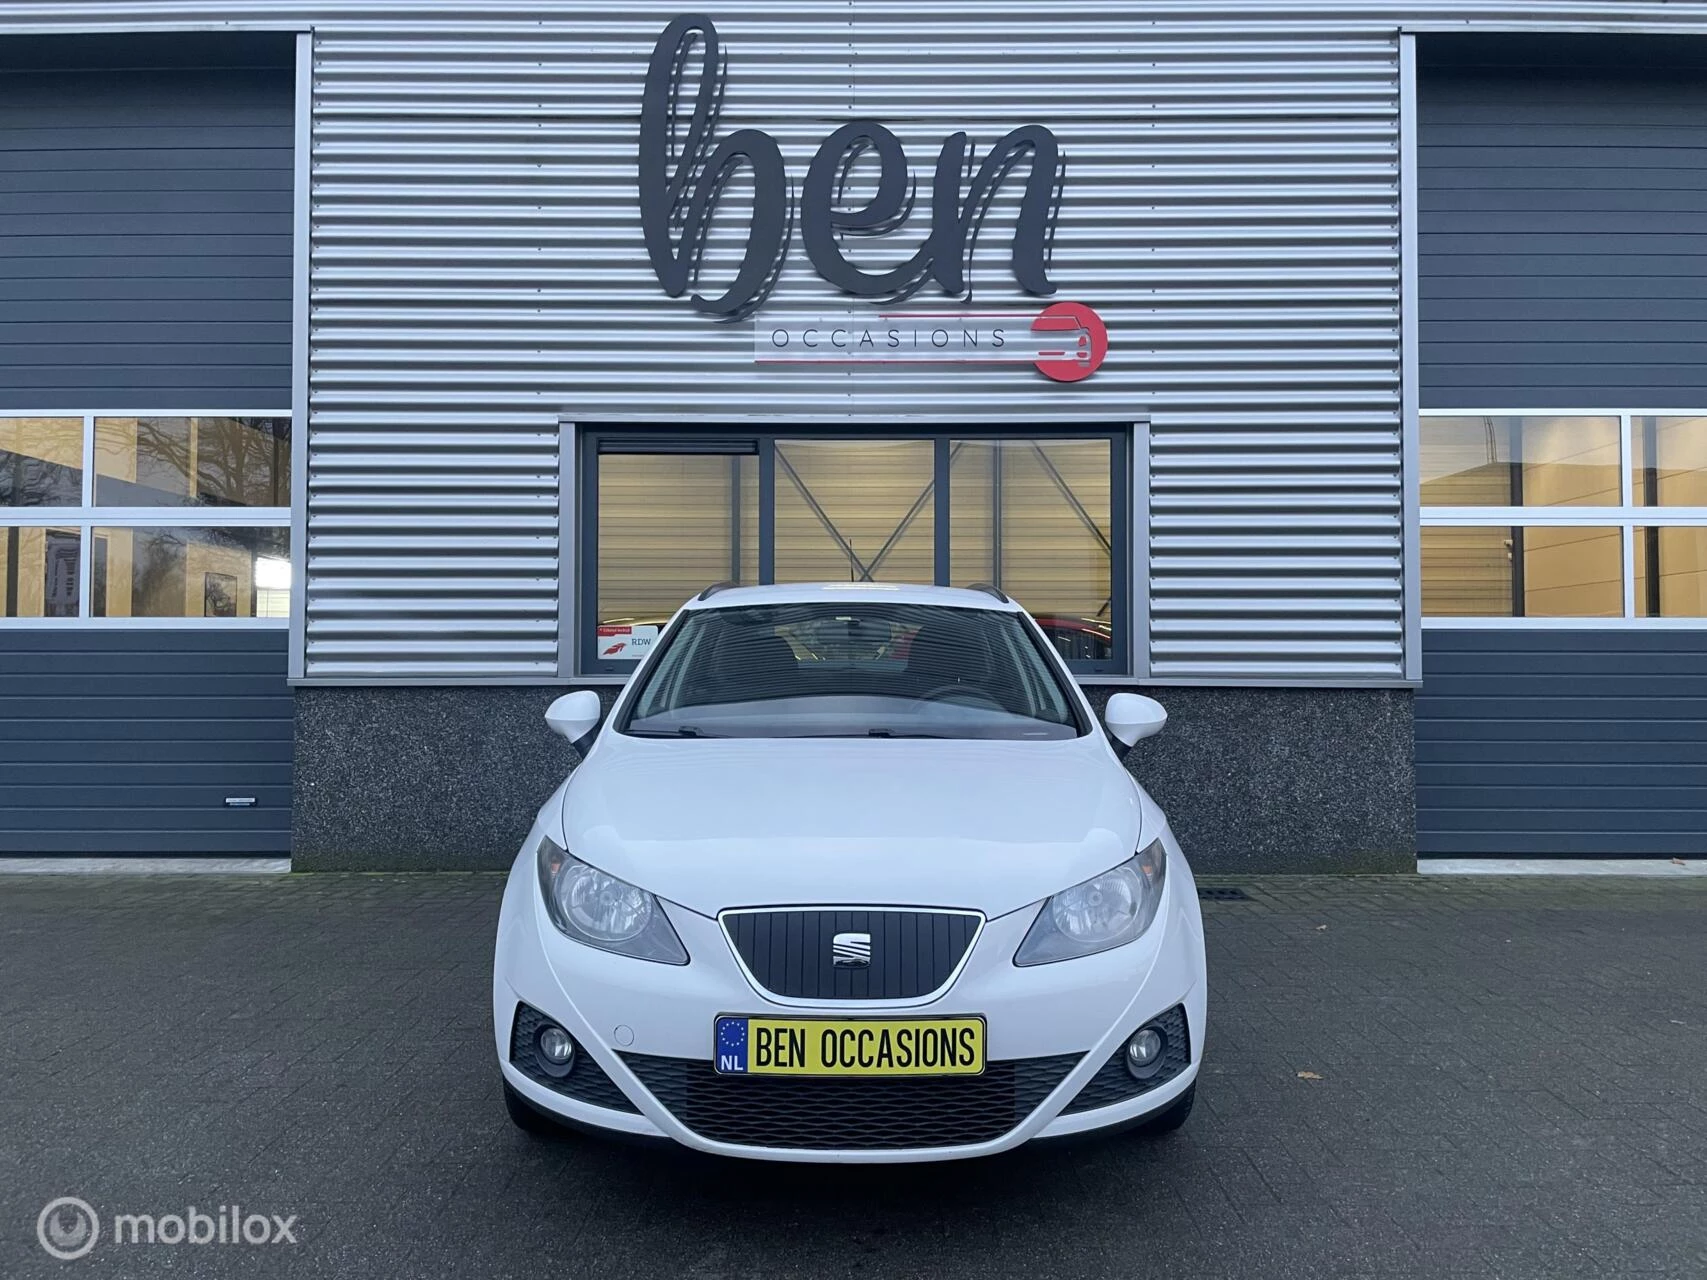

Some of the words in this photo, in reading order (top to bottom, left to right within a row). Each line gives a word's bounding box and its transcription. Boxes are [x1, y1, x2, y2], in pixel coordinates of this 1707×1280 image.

[638, 13, 1058, 315] ben
[771, 328, 1006, 348] OCCASIONS
[631, 638, 652, 646] RDW
[755, 1027, 806, 1067] BEN
[820, 1027, 975, 1068] OCCASIONS
[720, 1054, 744, 1071] NL
